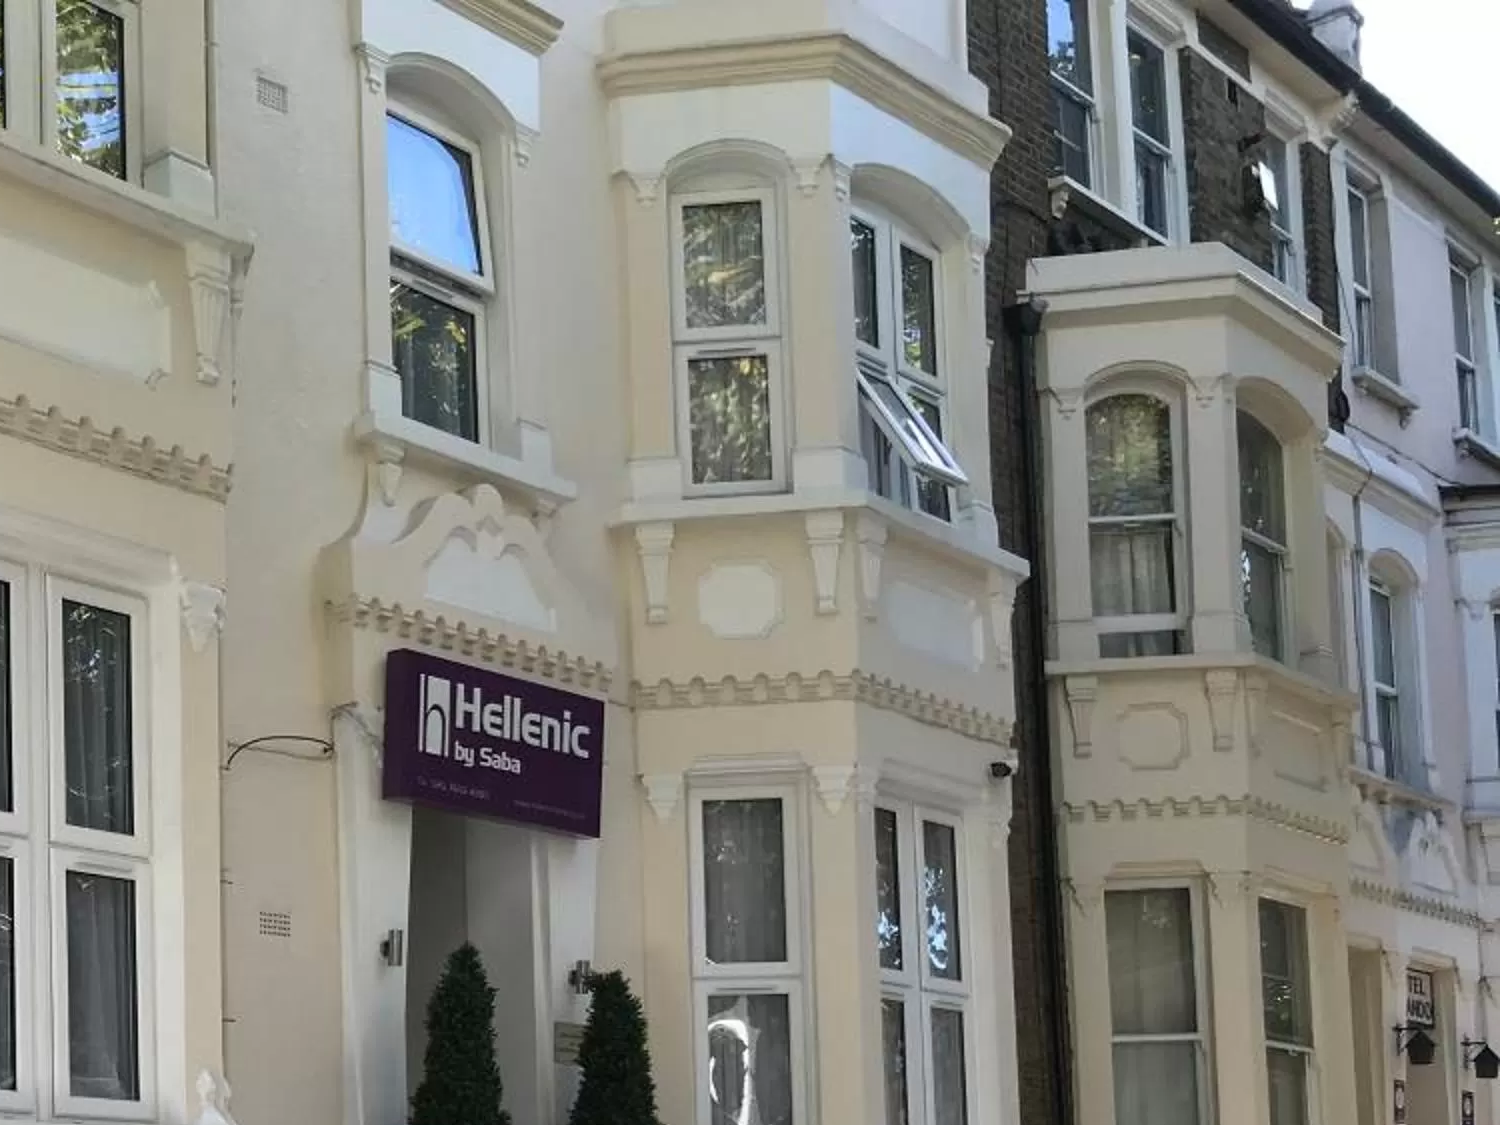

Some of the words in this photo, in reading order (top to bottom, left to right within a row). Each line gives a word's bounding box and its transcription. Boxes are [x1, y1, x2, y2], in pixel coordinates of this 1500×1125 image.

[455, 682, 591, 760] Hellenic
[454, 741, 475, 768] by
[480, 747, 522, 775] Saba
